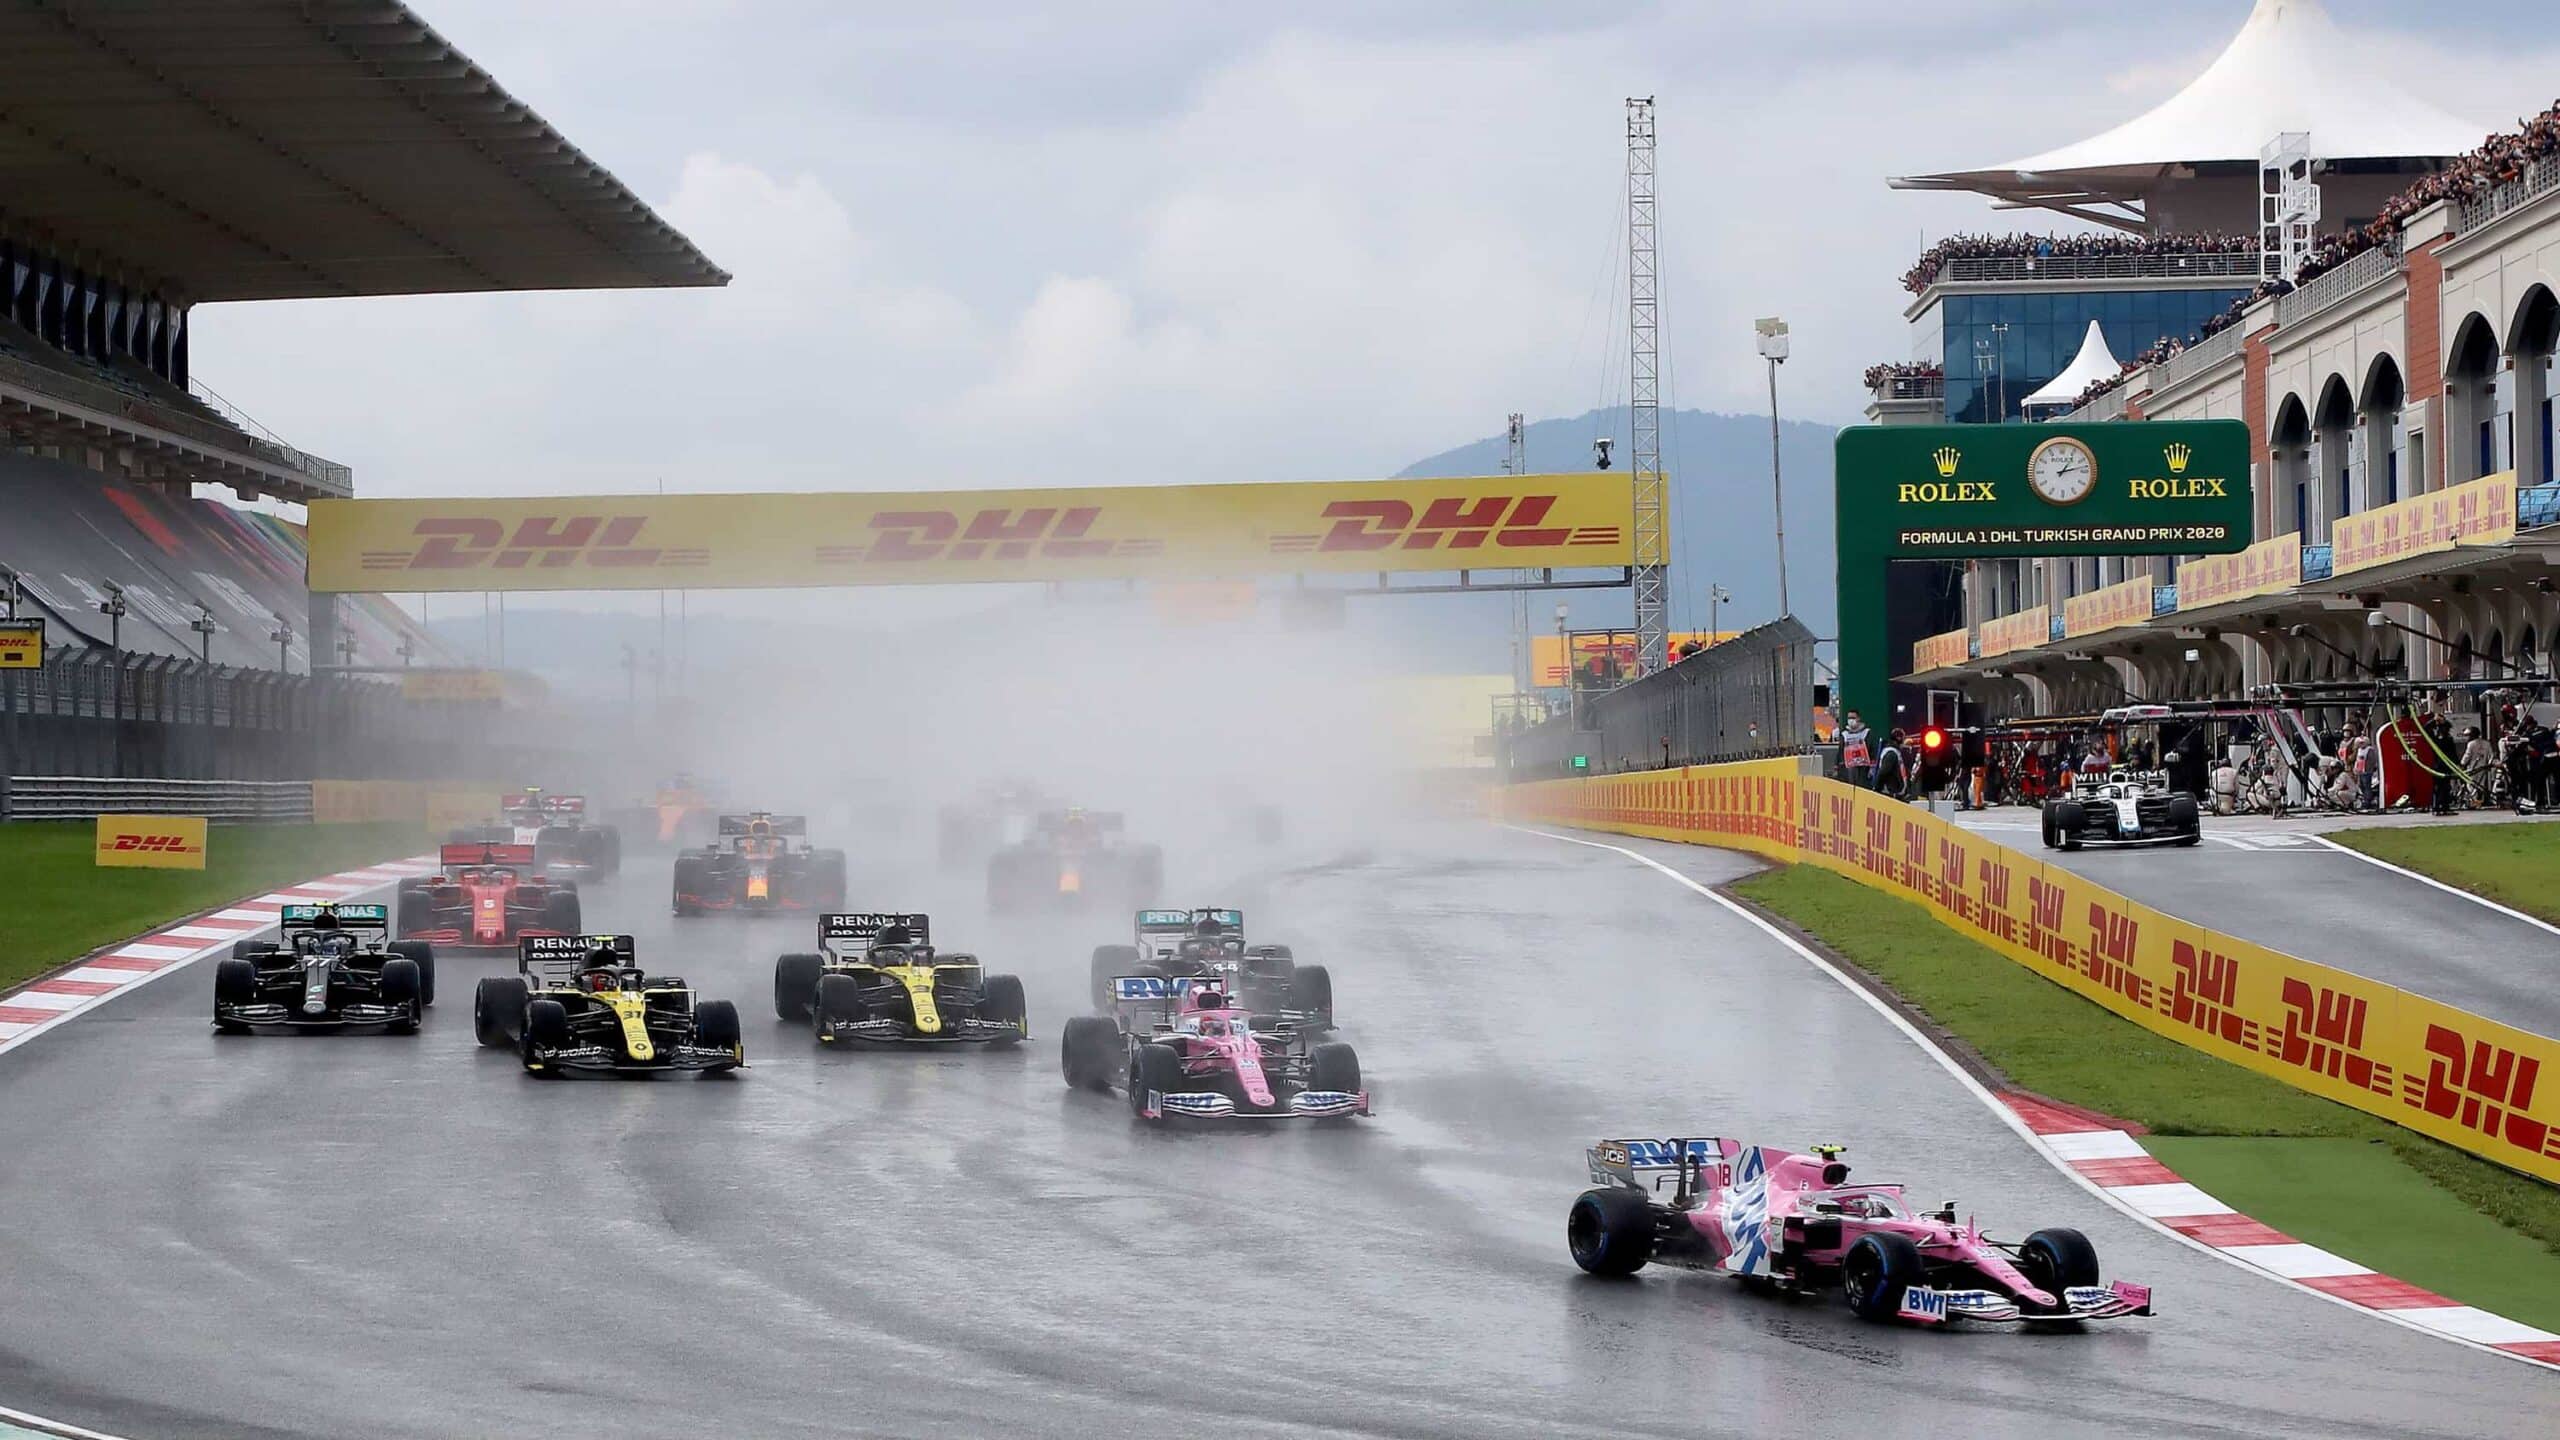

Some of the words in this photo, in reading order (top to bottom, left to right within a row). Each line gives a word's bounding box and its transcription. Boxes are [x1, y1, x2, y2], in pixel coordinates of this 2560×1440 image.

[1898, 482, 1997, 503] ROLEX
[2128, 478, 2228, 498] ROLEX
[408, 516, 662, 569] DHL
[864, 507, 1116, 562] DHL
[1319, 496, 1572, 552] DHL
[1901, 531, 1976, 545] FORMULA
[1979, 531, 1987, 543] 1
[1990, 530, 2021, 543] DHL
[2023, 529, 2089, 543] TURKISH
[2091, 528, 2146, 541] GRAND
[2149, 528, 2183, 540] PRIX
[2186, 526, 2225, 540] 2020
[114, 834, 187, 852] DHL
[1802, 790, 1824, 853] DHL
[1831, 795, 1859, 863] DHL
[1865, 807, 1895, 880] DHL
[1904, 821, 1932, 895] DHL
[1940, 837, 1968, 919] DHL
[483, 899, 495, 909] 5
[1980, 858, 2013, 942] DHL
[2029, 876, 2068, 966] DHL
[303, 955, 341, 967] 77
[1212, 962, 1238, 972] 44
[2088, 902, 2140, 1003] DHL
[623, 1010, 642, 1019] 31
[2171, 938, 2244, 1045] DHL
[2281, 976, 2374, 1090] DHL
[2424, 1023, 2548, 1154] DHL
[1603, 1149, 1626, 1163] JCB
[1718, 1163, 1731, 1187] 18
[1908, 1289, 1945, 1315] BWT
